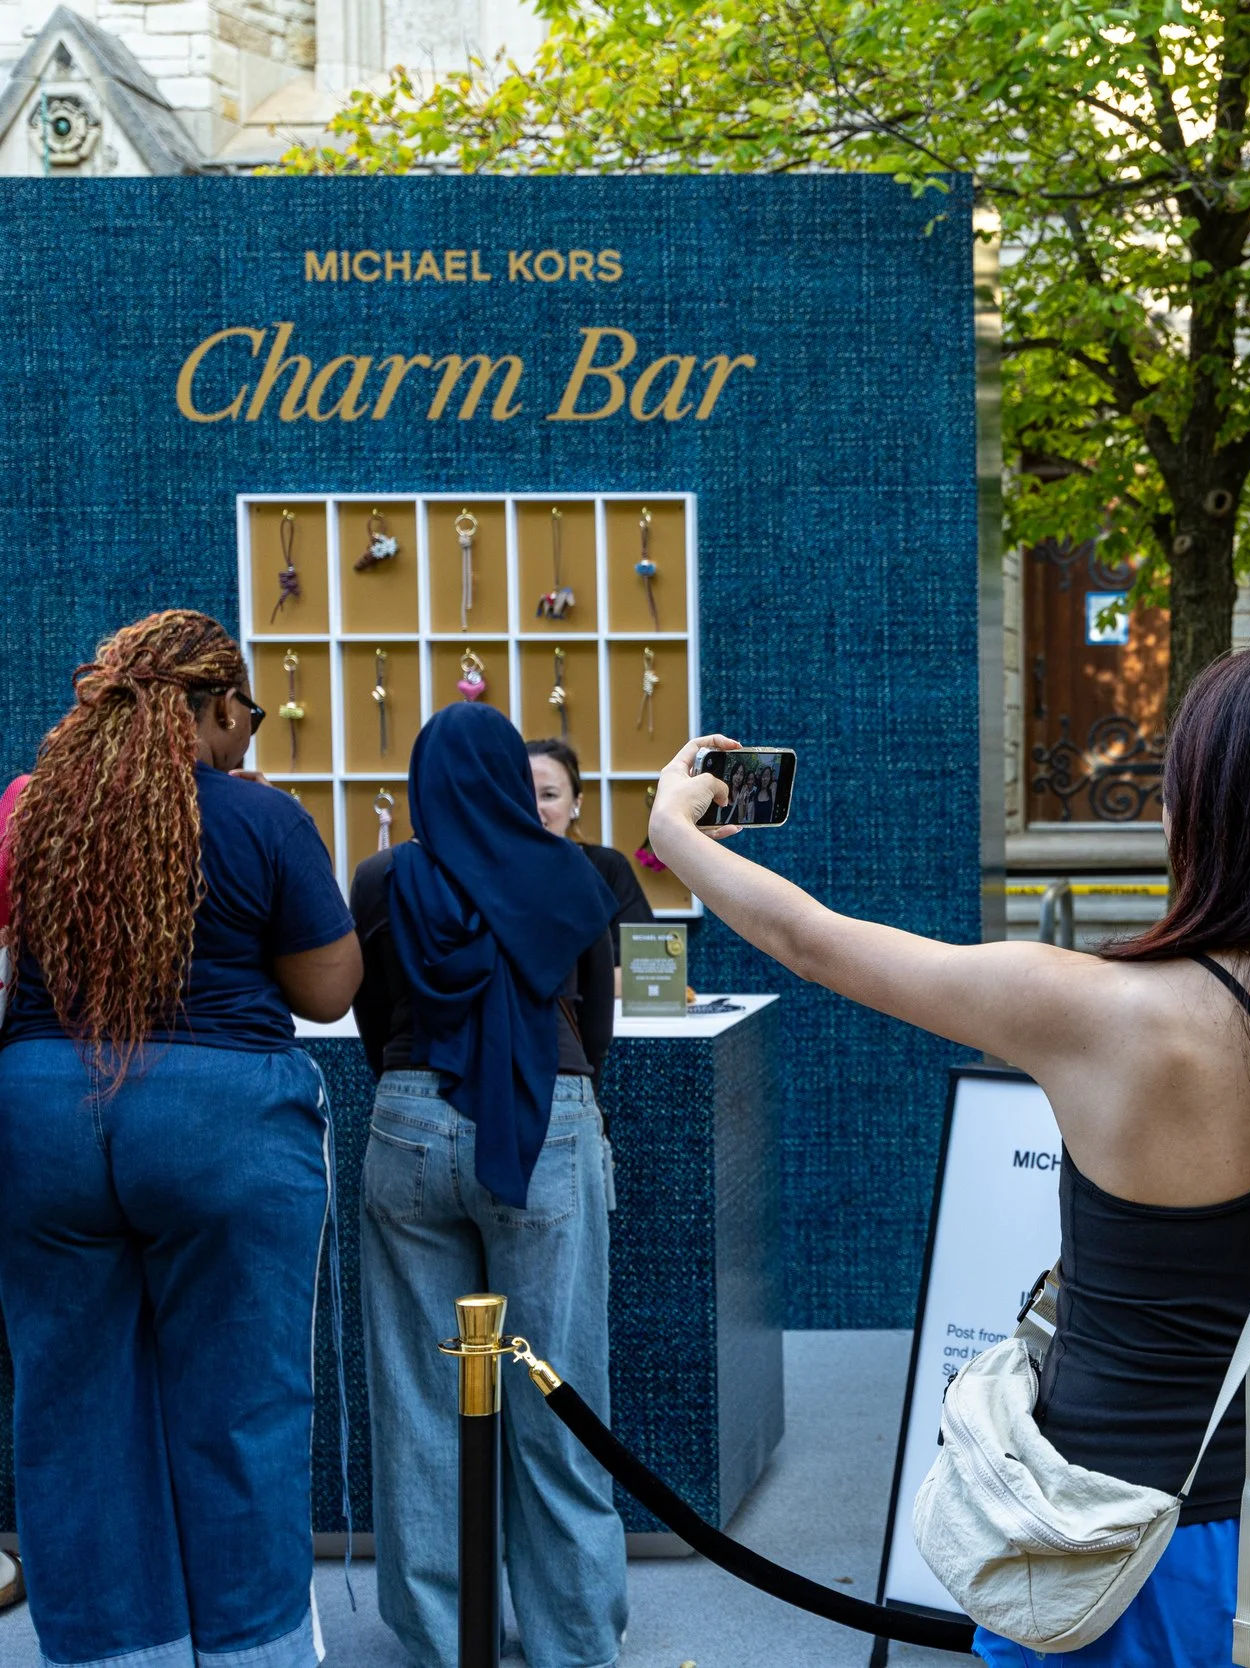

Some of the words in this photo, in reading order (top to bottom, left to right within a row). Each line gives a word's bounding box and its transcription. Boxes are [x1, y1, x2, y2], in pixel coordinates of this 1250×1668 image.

[304, 249, 491, 282] MICHAEL
[508, 249, 623, 282] KORS
[176, 322, 523, 422] Charm
[546, 326, 756, 421] Bar
[1013, 1150, 1061, 1171] MICH
[946, 1323, 975, 1340] Post
[979, 1328, 1008, 1343] from
[943, 1346, 969, 1359] and
